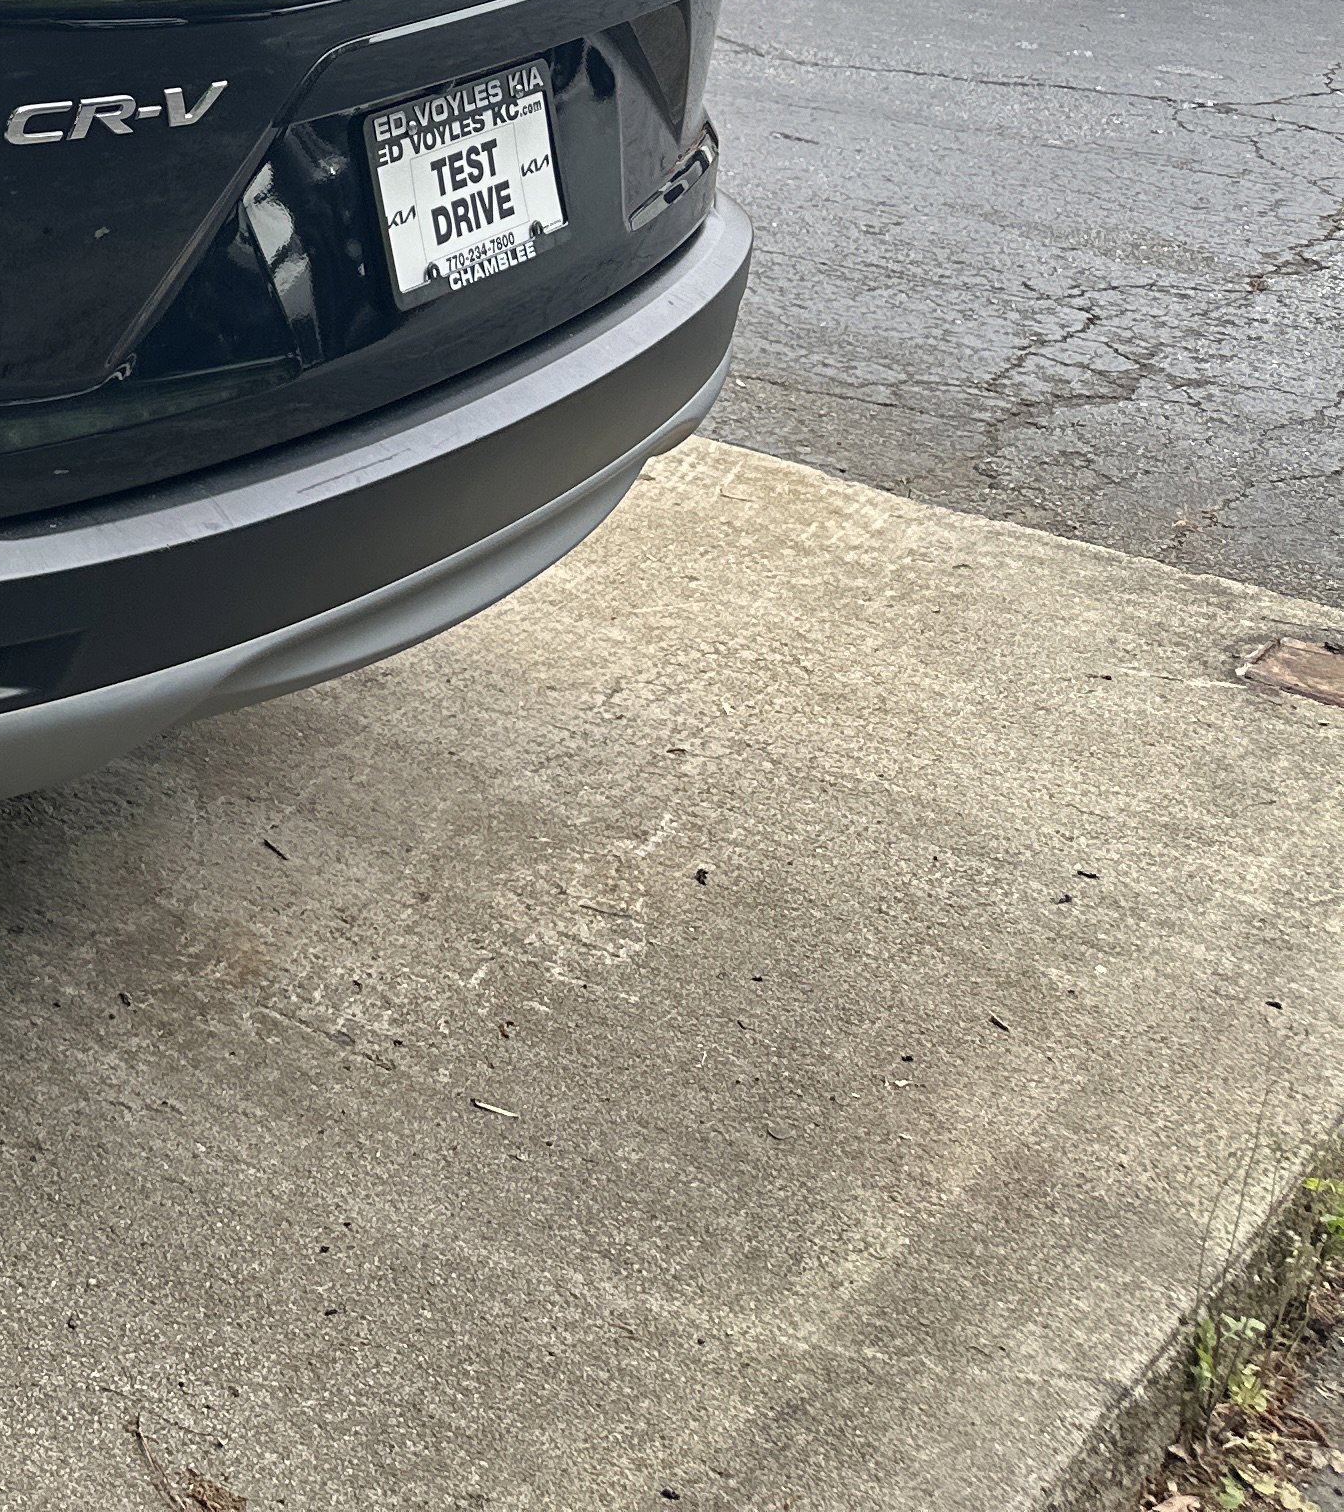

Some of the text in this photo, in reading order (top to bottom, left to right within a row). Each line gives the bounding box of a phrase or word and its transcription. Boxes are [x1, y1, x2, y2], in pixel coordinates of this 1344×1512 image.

[4, 80, 228, 145] CR-V
[373, 66, 544, 142] ED VOYLES KIA
[377, 140, 404, 167] ED
[409, 111, 486, 155] VOYLES
[430, 138, 498, 196] TEST
[431, 180, 515, 246] DRIVE
[445, 231, 515, 272] 770-234-7800
[449, 242, 537, 291] CHAMBLEE
